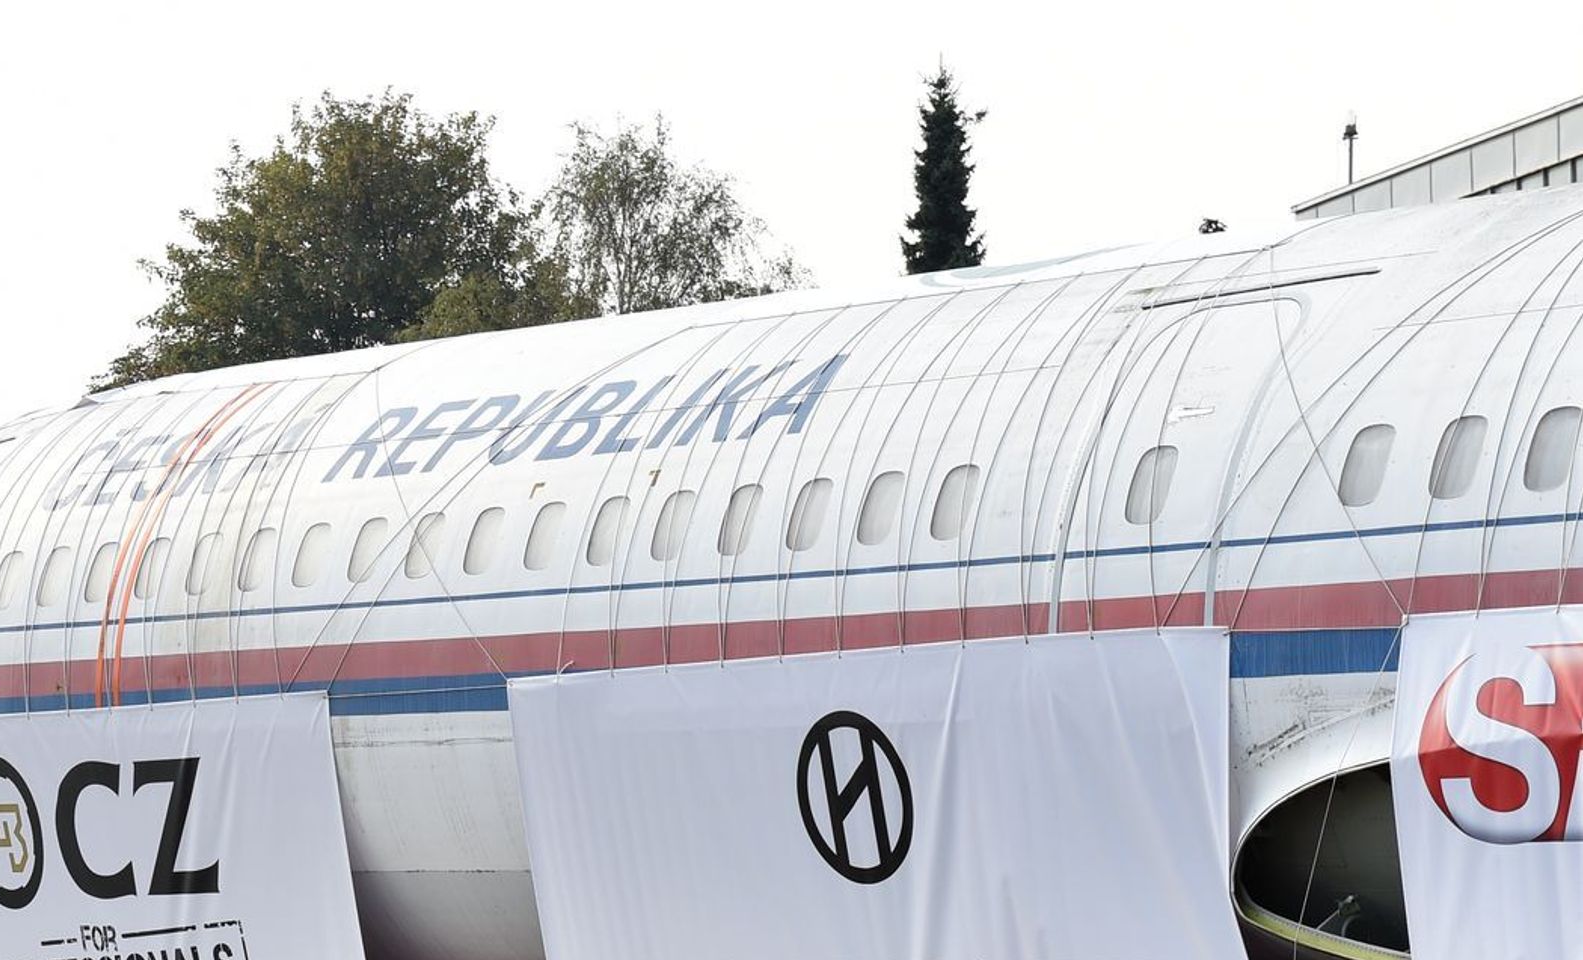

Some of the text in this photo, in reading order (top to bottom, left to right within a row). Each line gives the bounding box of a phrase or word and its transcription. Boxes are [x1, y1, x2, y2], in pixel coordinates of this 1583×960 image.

[321, 354, 851, 484] REPUBLIKA
[56, 757, 220, 899] CZ
[79, 925, 119, 951] FOR
